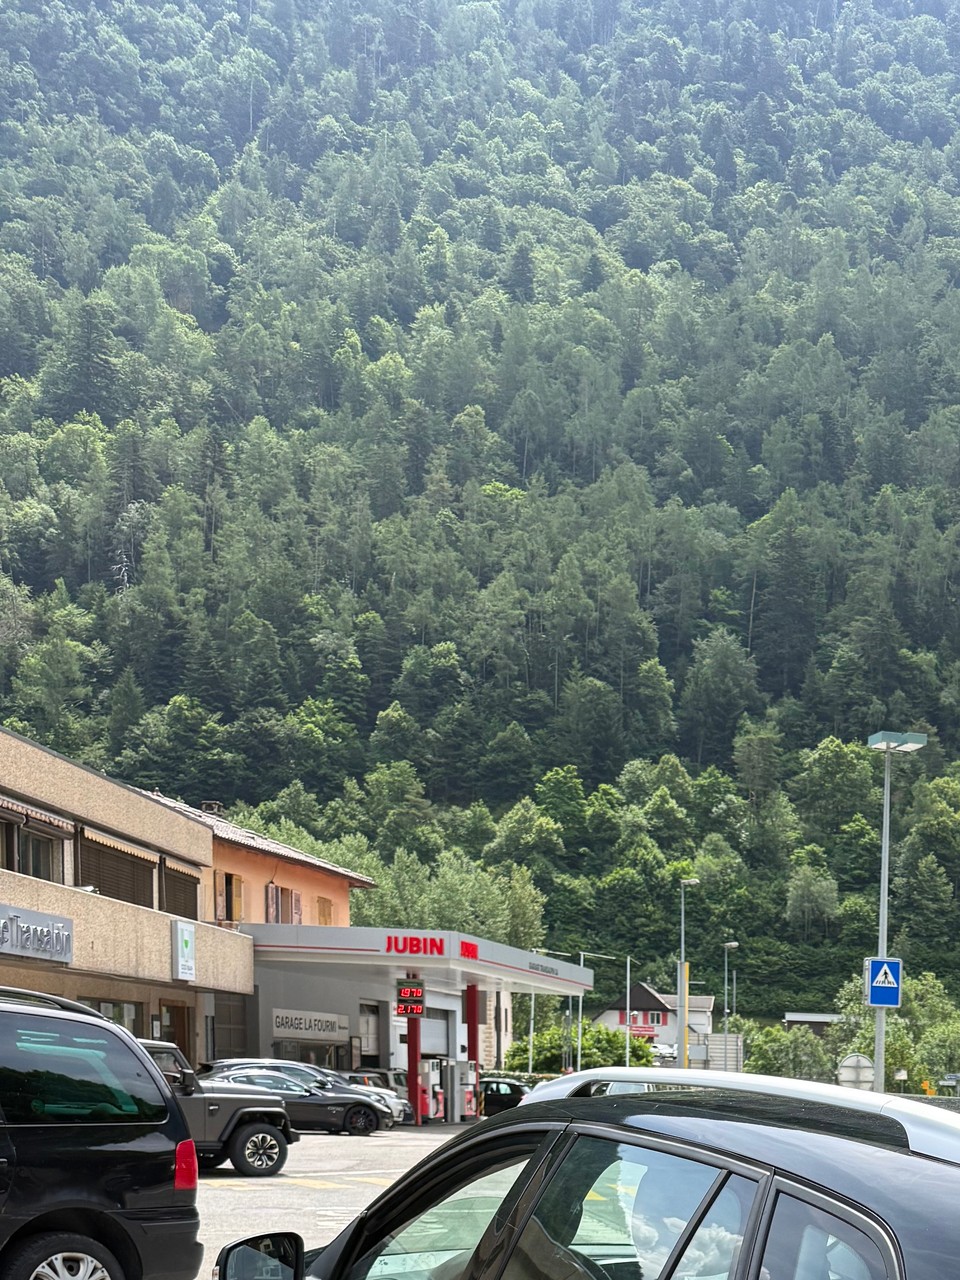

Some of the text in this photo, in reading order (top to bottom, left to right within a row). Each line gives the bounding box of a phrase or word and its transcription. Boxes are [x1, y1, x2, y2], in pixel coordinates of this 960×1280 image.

[386, 936, 444, 955] JUBIN
[275, 1015, 336, 1033] GARAGE LA FOURMI
